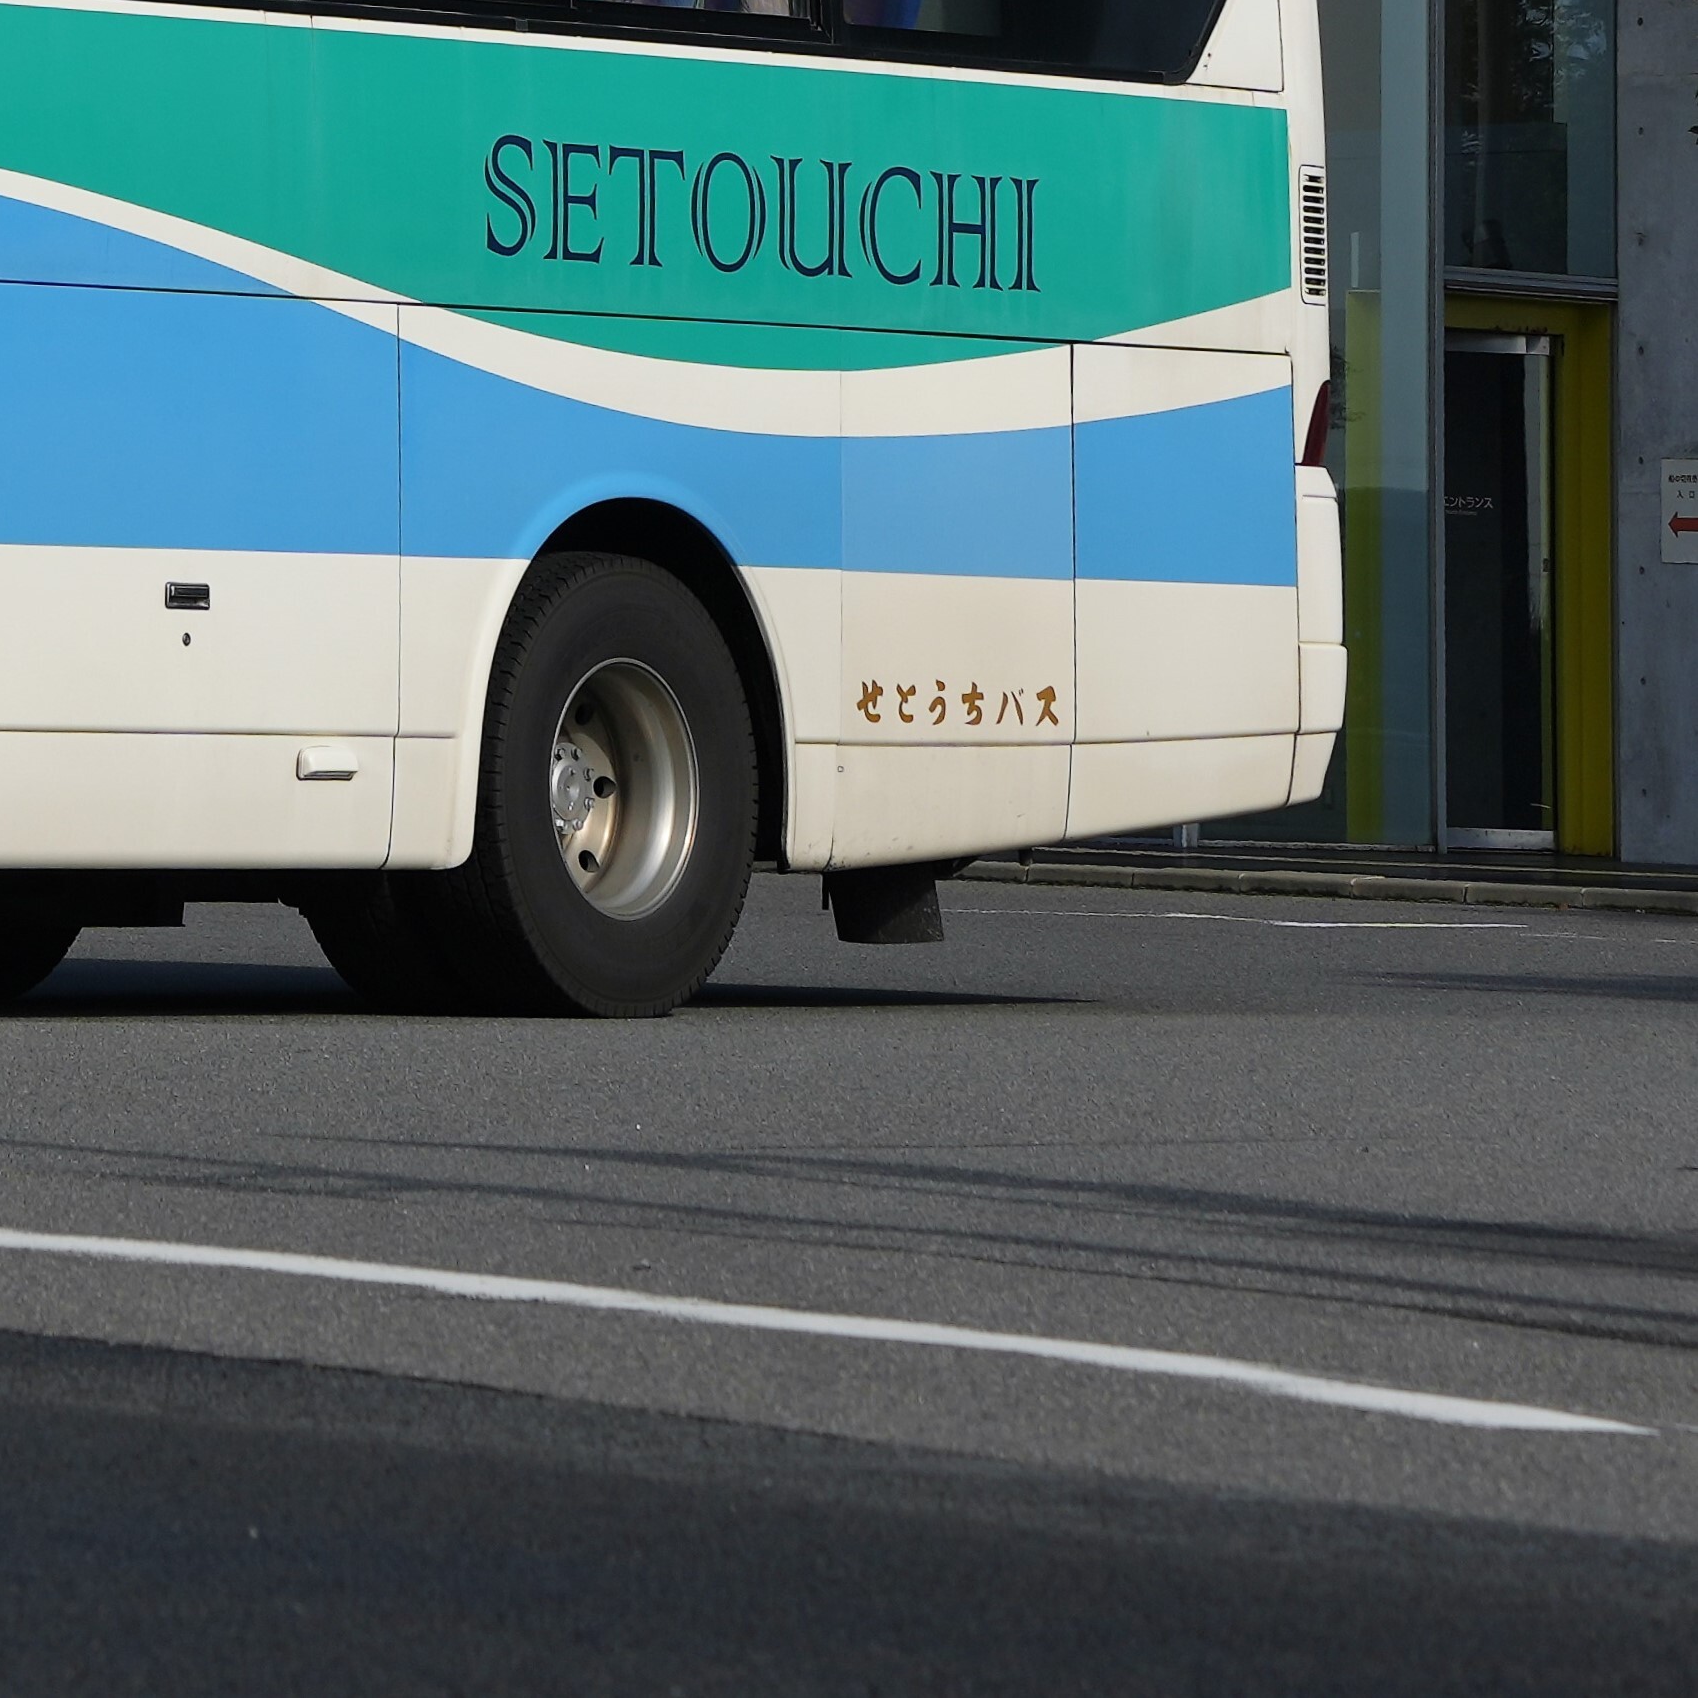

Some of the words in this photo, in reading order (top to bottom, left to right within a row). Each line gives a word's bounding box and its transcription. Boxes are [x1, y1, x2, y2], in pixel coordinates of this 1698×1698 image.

[484, 134, 1042, 292] SETOUCHI
[856, 679, 1059, 727] せとうちバス
